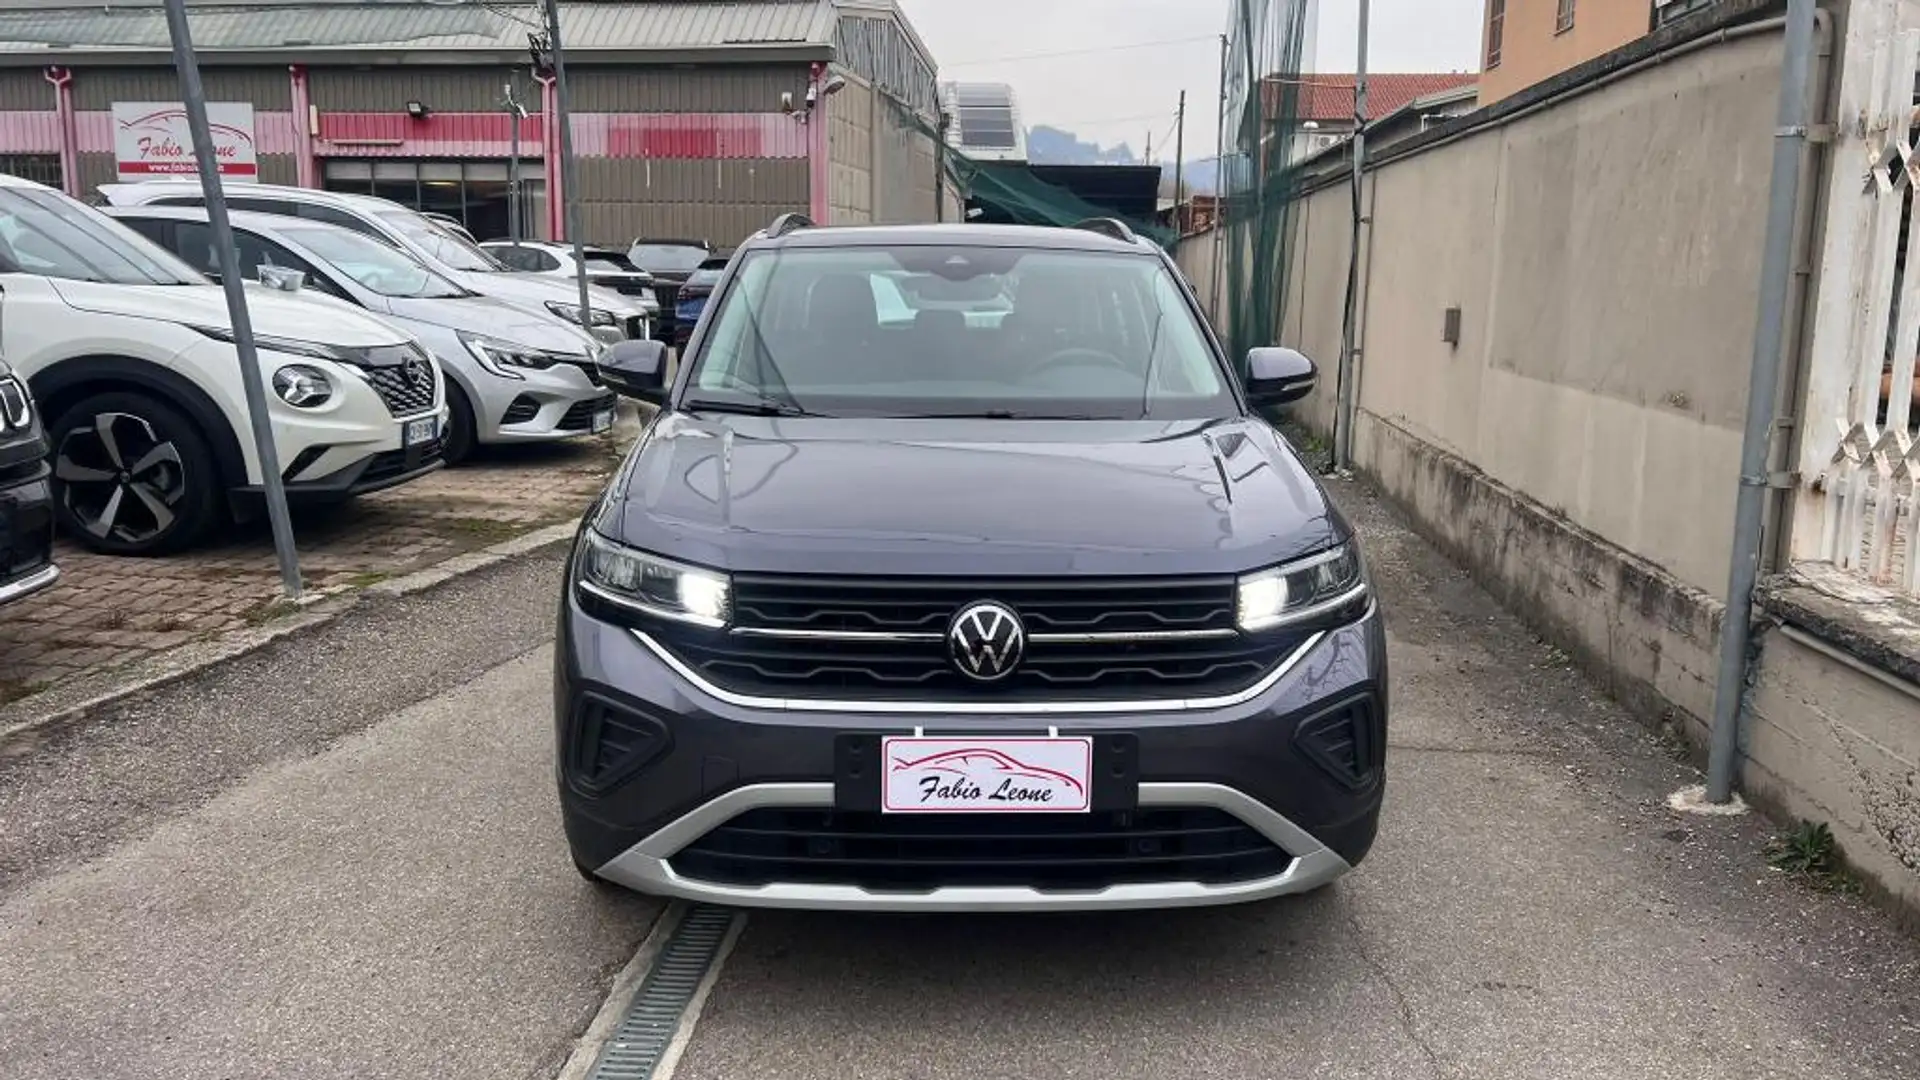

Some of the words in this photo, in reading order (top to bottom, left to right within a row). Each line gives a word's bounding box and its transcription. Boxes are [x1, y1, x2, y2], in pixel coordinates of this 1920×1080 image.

[137, 136, 183, 160] Fabio
[918, 775, 983, 802] Fabio
[988, 777, 1053, 802] Leone
